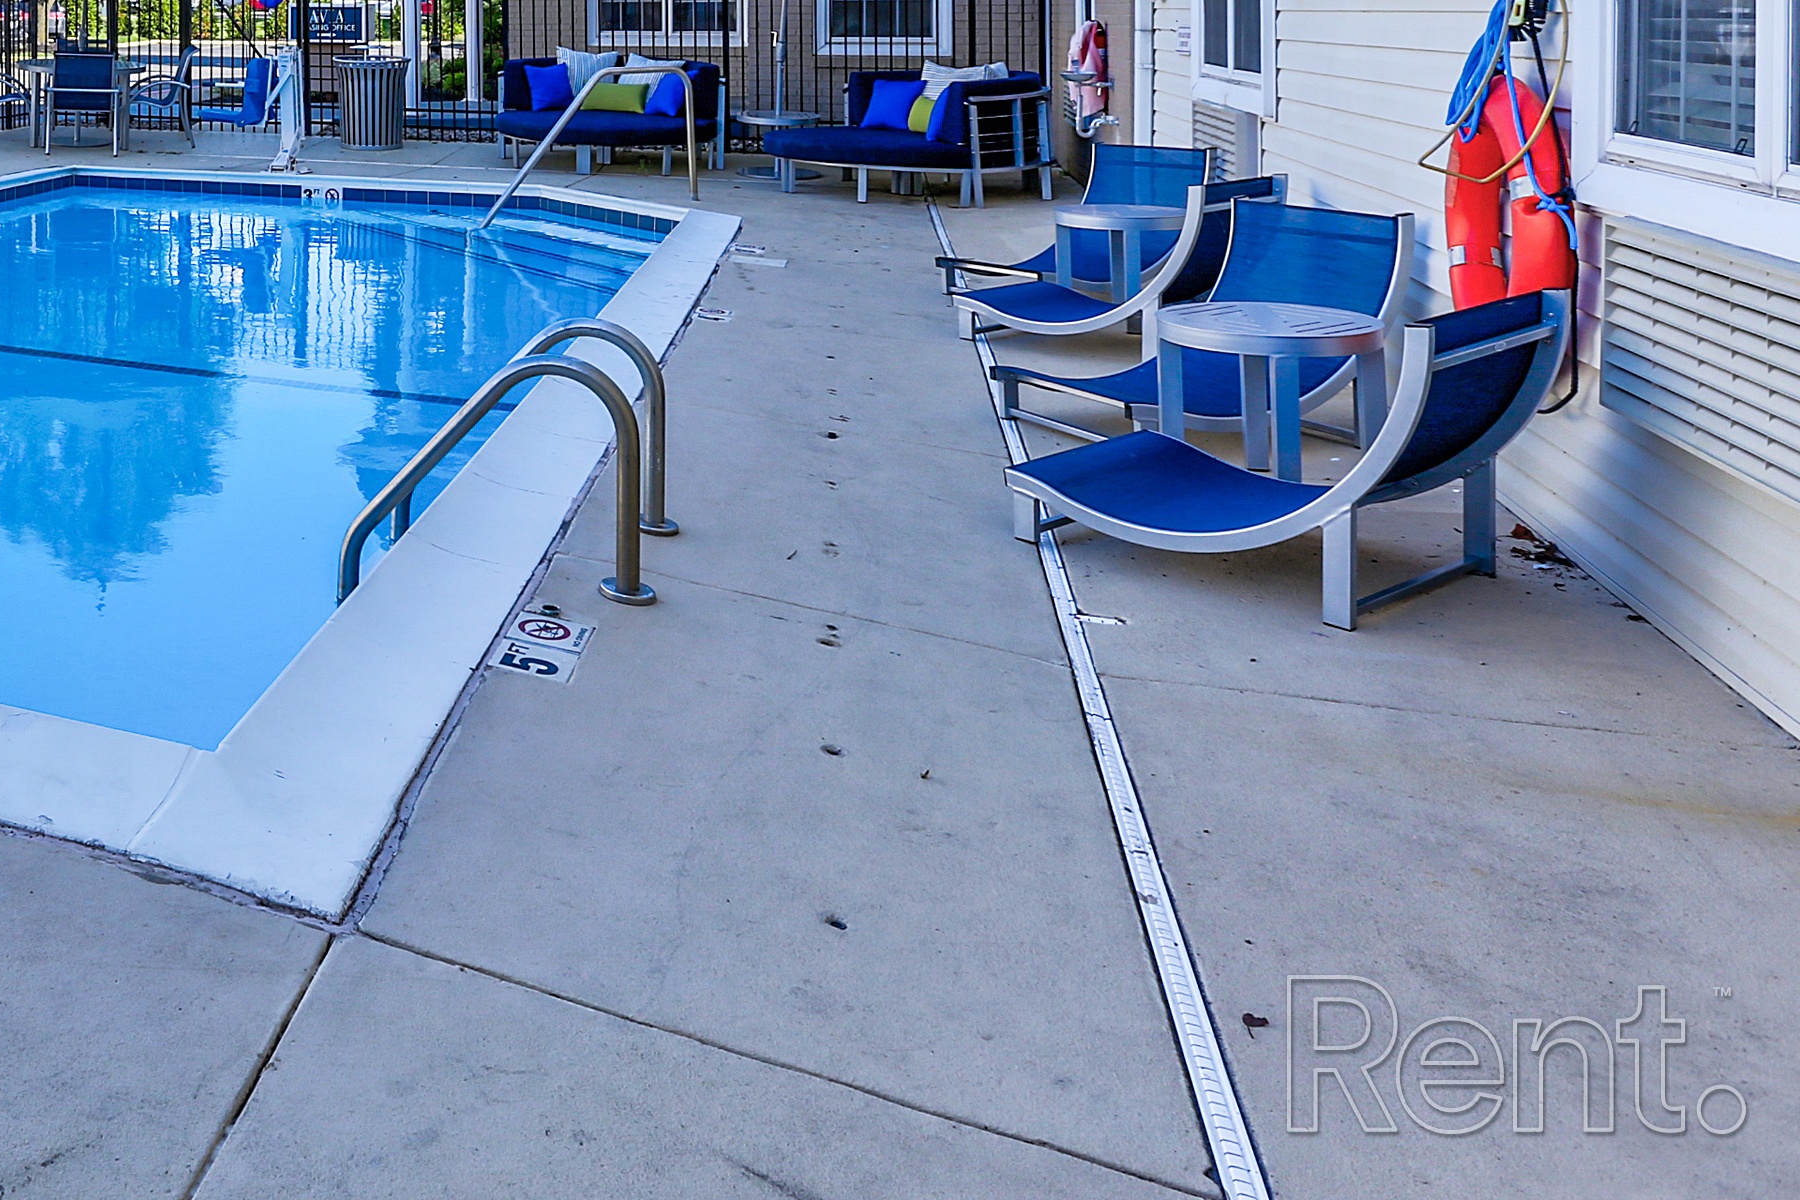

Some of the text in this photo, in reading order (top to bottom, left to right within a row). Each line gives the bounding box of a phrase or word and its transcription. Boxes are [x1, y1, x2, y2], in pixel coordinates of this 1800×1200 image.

[309, 9, 344, 24] AVA
[499, 642, 559, 676] 5 FT
